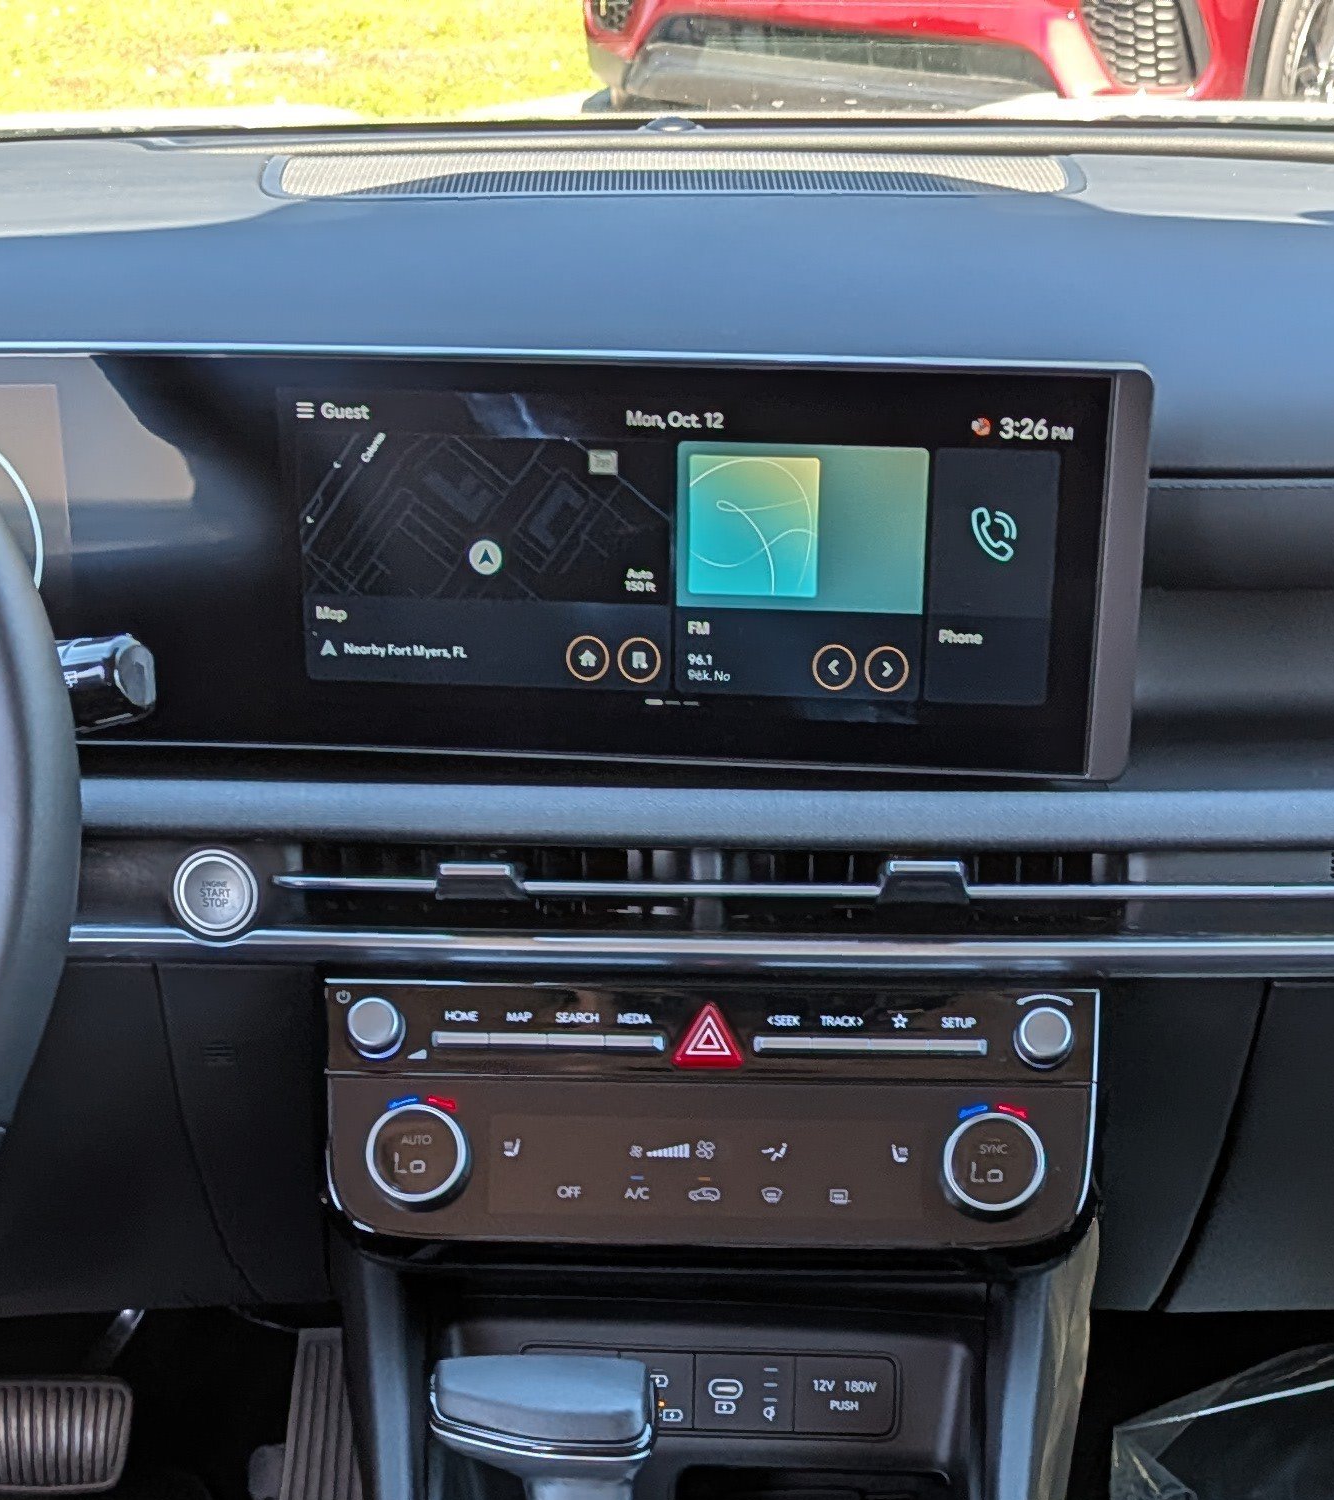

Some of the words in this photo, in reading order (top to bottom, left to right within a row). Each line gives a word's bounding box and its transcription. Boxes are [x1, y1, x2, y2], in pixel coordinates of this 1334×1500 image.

[320, 402, 371, 420] Guest
[625, 409, 667, 430] Mon,
[703, 412, 725, 429] 12
[999, 416, 1049, 441] 3:26
[1050, 426, 1075, 441] PM
[626, 568, 654, 580] Auto
[624, 580, 645, 592] 150
[315, 605, 348, 623] Map
[687, 620, 711, 636] FM
[938, 628, 984, 645] Phone
[343, 642, 386, 658] Nearby
[387, 643, 412, 658] Fort
[412, 644, 452, 660] Myers,
[452, 645, 468, 659] FL
[687, 652, 713, 666] 96.1
[713, 670, 731, 682] No
[199, 888, 231, 898] START
[202, 898, 229, 908] STOP
[443, 1010, 479, 1022] HOME
[505, 1011, 533, 1023] MAP
[554, 1011, 600, 1024] SEARCH
[616, 1012, 653, 1025] MEDIA
[940, 1016, 977, 1029] SETUP
[400, 1134, 433, 1146] AUTO
[979, 1143, 1009, 1155] SYNC
[556, 1185, 582, 1199] OFF
[623, 1186, 650, 1200] A/C
[812, 1379, 836, 1393] 12V
[829, 1399, 860, 1412] PUSH
